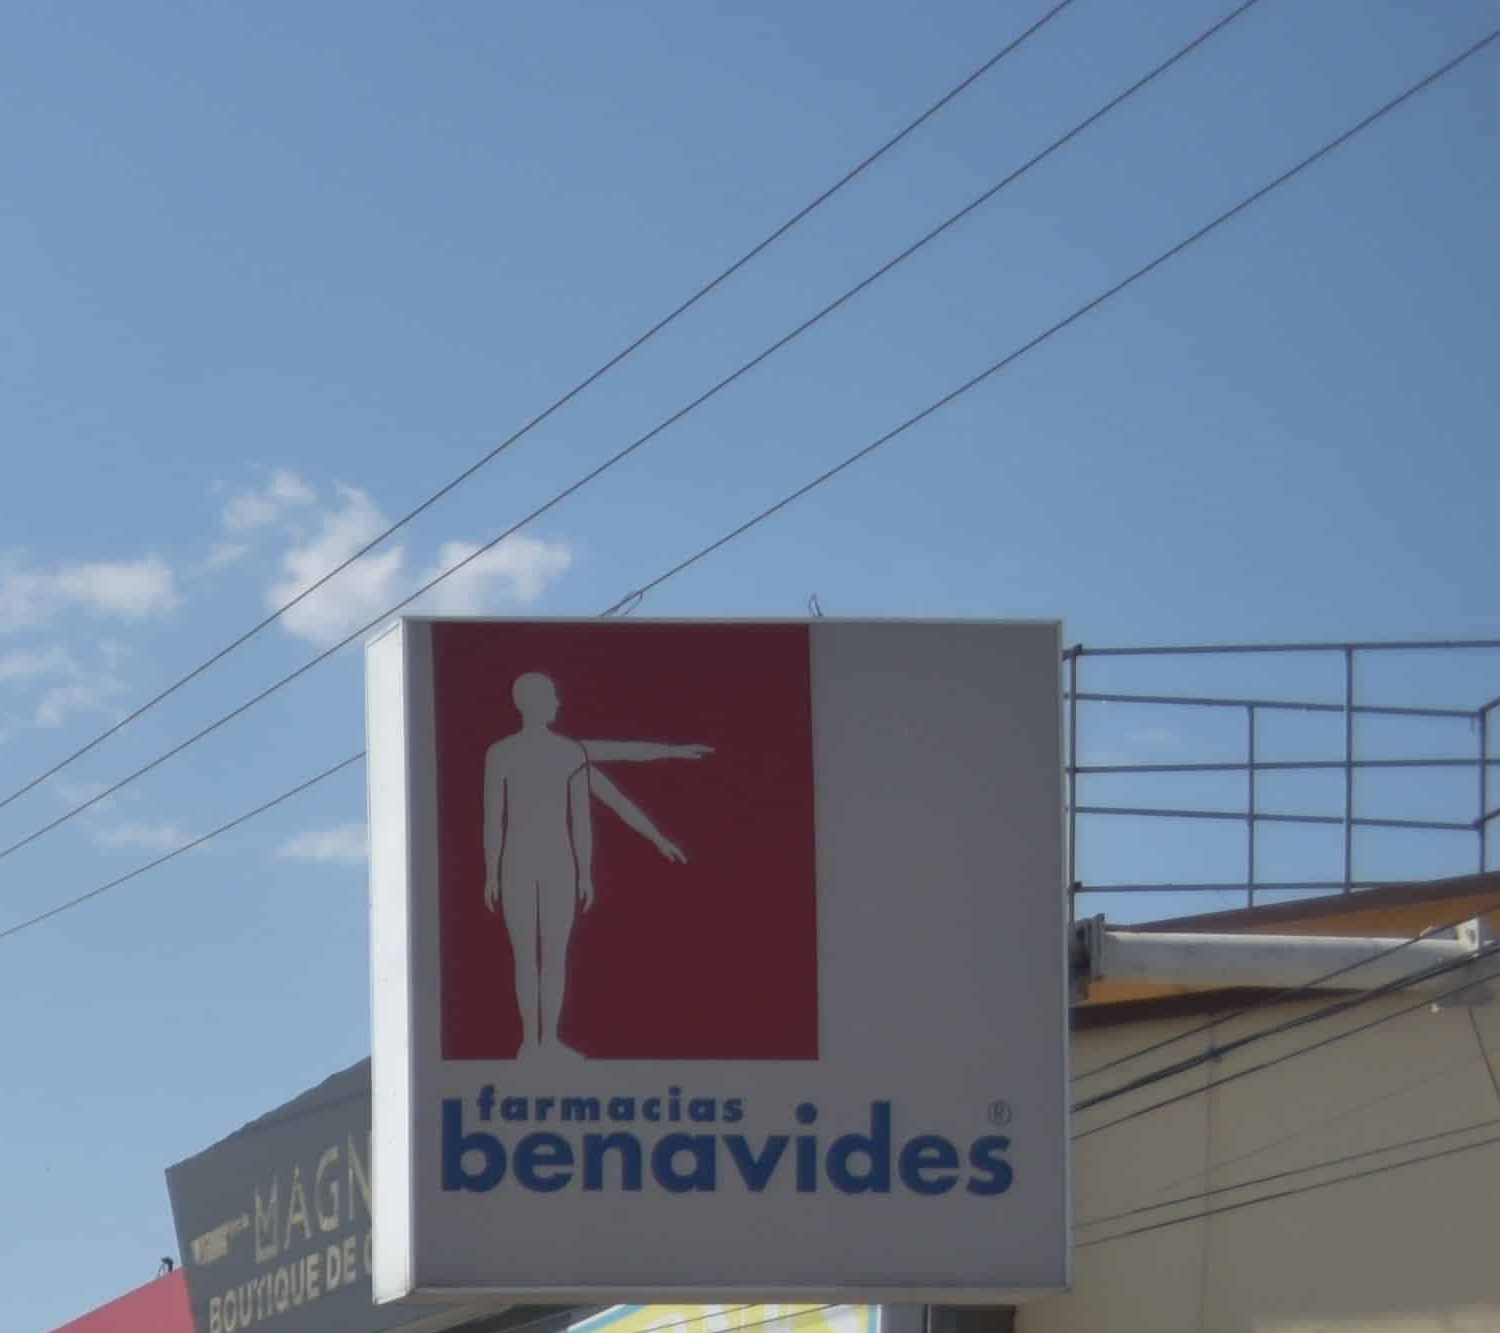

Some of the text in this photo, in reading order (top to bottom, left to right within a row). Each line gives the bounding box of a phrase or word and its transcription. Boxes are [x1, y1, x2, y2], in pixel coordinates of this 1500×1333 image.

[477, 1084, 744, 1122] farmacias
[441, 1099, 1014, 1196] benavides
[254, 1130, 373, 1264] MAGN
[326, 1234, 357, 1292] DE
